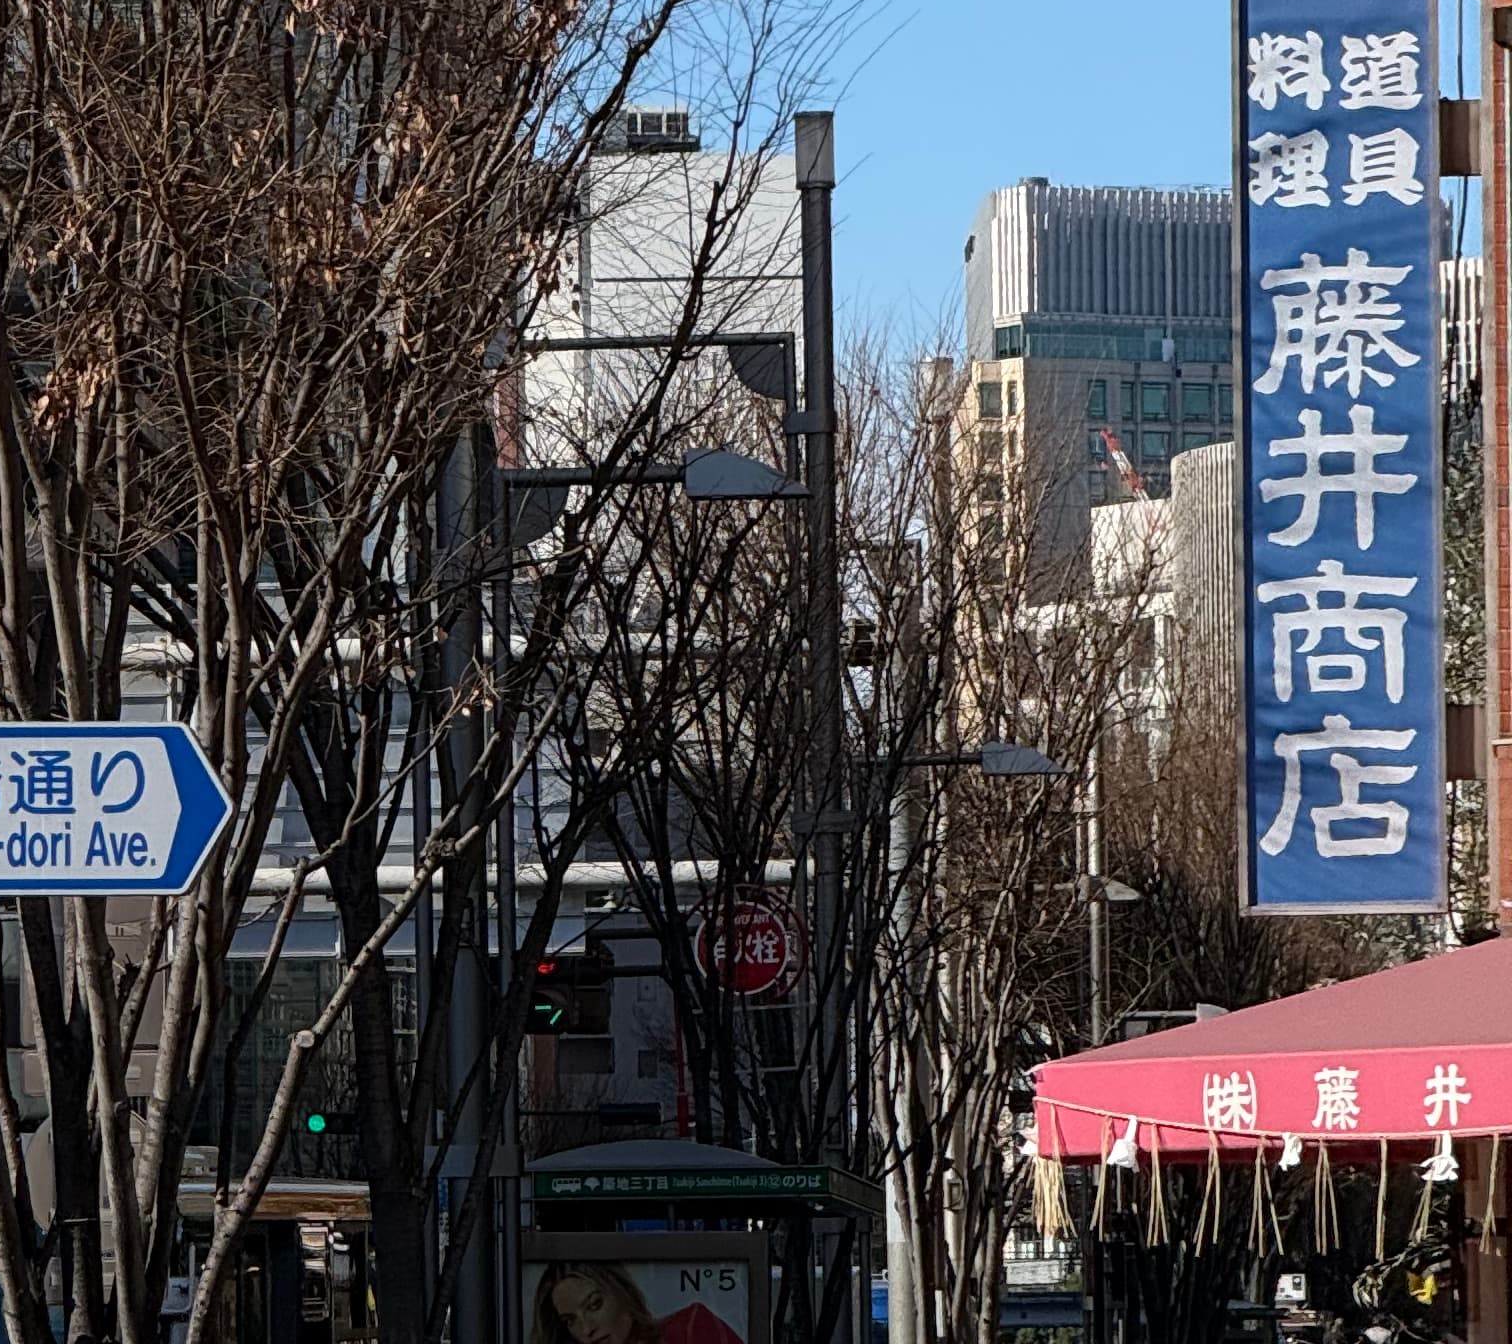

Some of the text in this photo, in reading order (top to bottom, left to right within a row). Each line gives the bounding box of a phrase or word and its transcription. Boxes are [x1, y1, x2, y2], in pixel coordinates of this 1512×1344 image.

[1253, 247, 1421, 857] 藤井商店
[85, 820, 158, 868] Ave.
[783, 1174, 821, 1189] のりば
